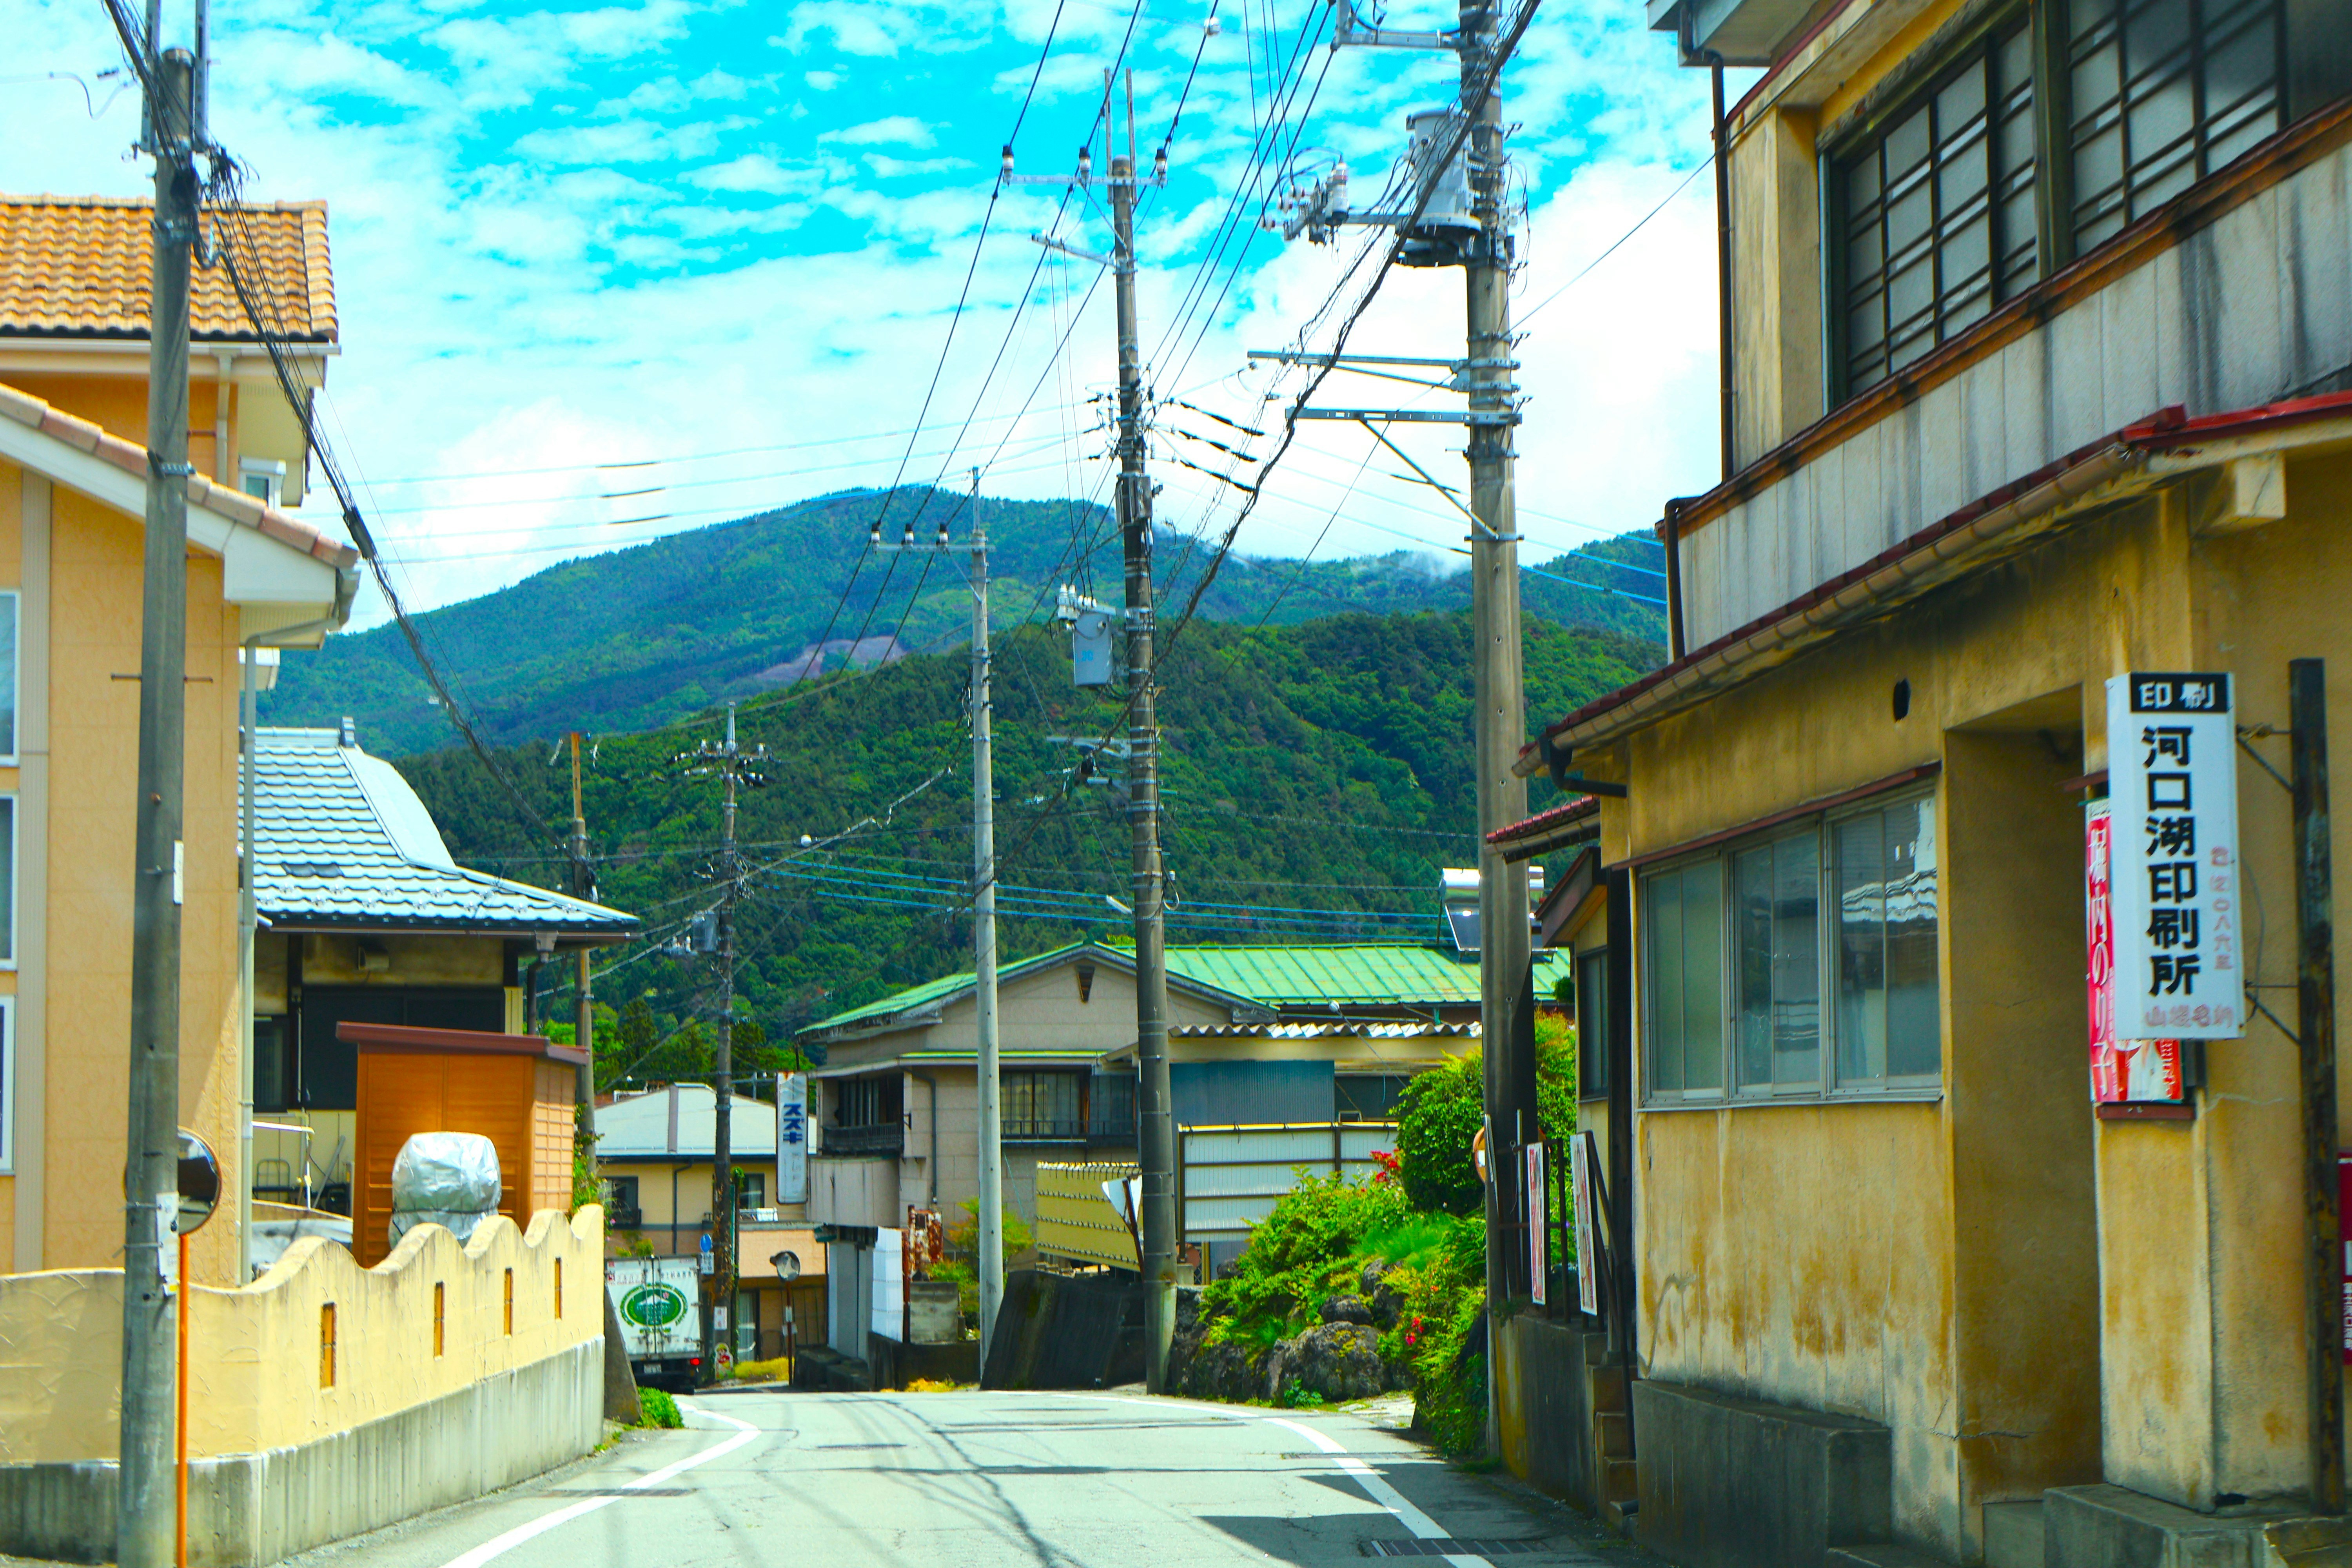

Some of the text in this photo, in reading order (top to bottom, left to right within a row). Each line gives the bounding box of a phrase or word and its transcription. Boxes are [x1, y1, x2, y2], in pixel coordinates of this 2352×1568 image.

[2139, 681, 2215, 709] 印刷
[2141, 725, 2201, 996] 河口湖印刷所
[783, 1103, 804, 1143] スズキ
